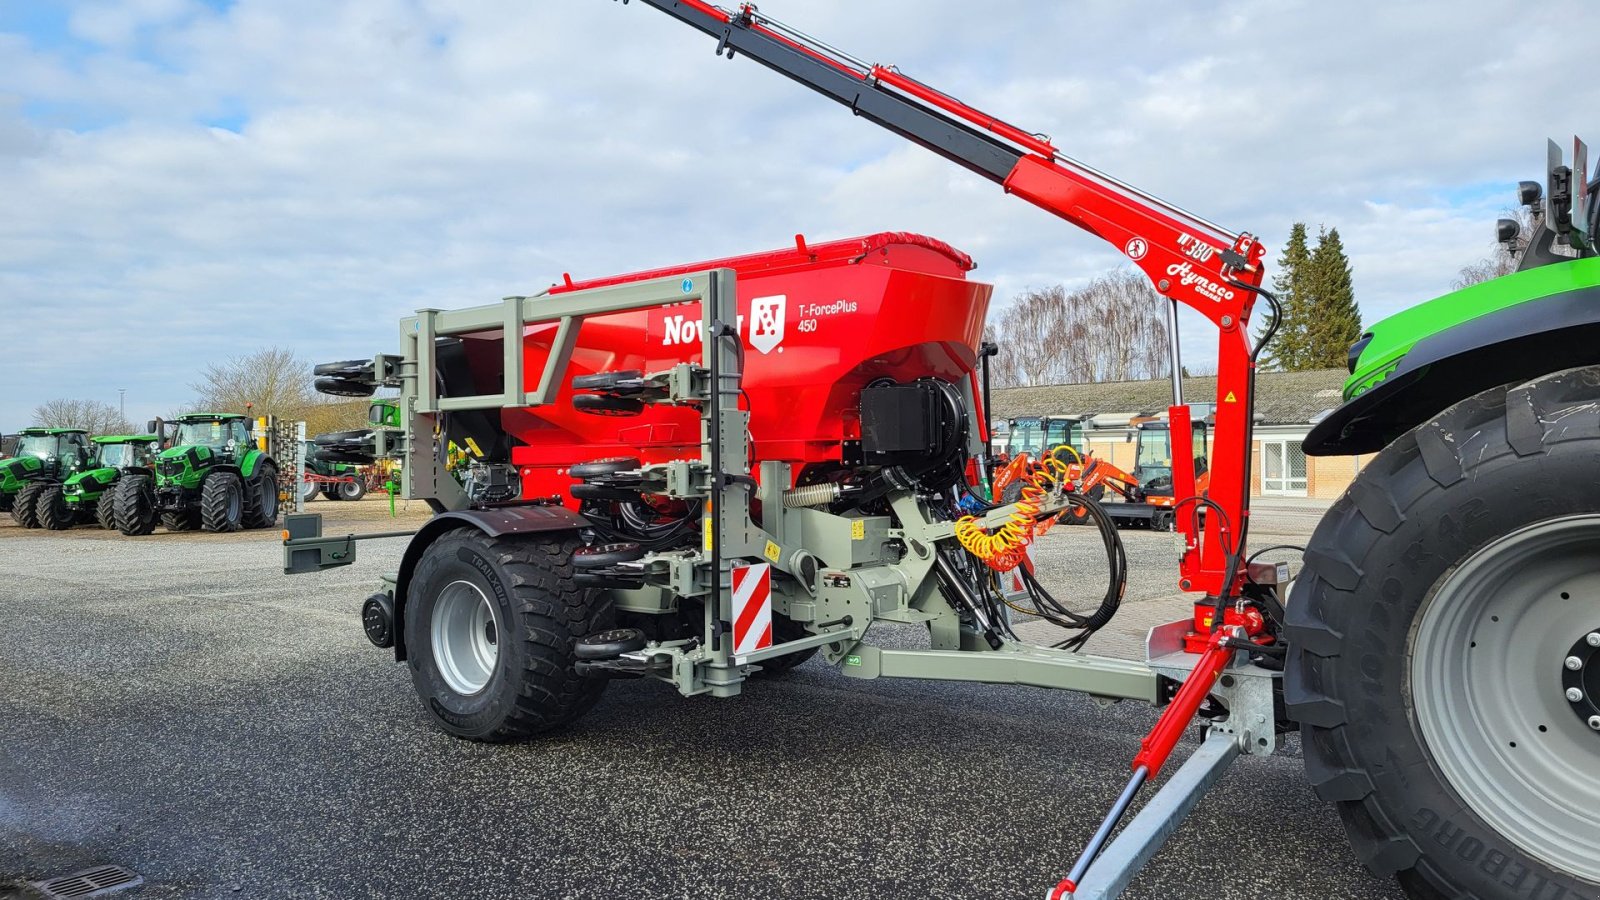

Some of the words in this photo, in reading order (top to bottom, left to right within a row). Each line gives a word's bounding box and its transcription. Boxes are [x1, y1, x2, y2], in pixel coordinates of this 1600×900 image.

[1166, 261, 1234, 300] Hymaco
[798, 299, 857, 317] T-ForcePlus
[797, 319, 817, 332] 450
[471, 554, 508, 607] TRAILXBIB
